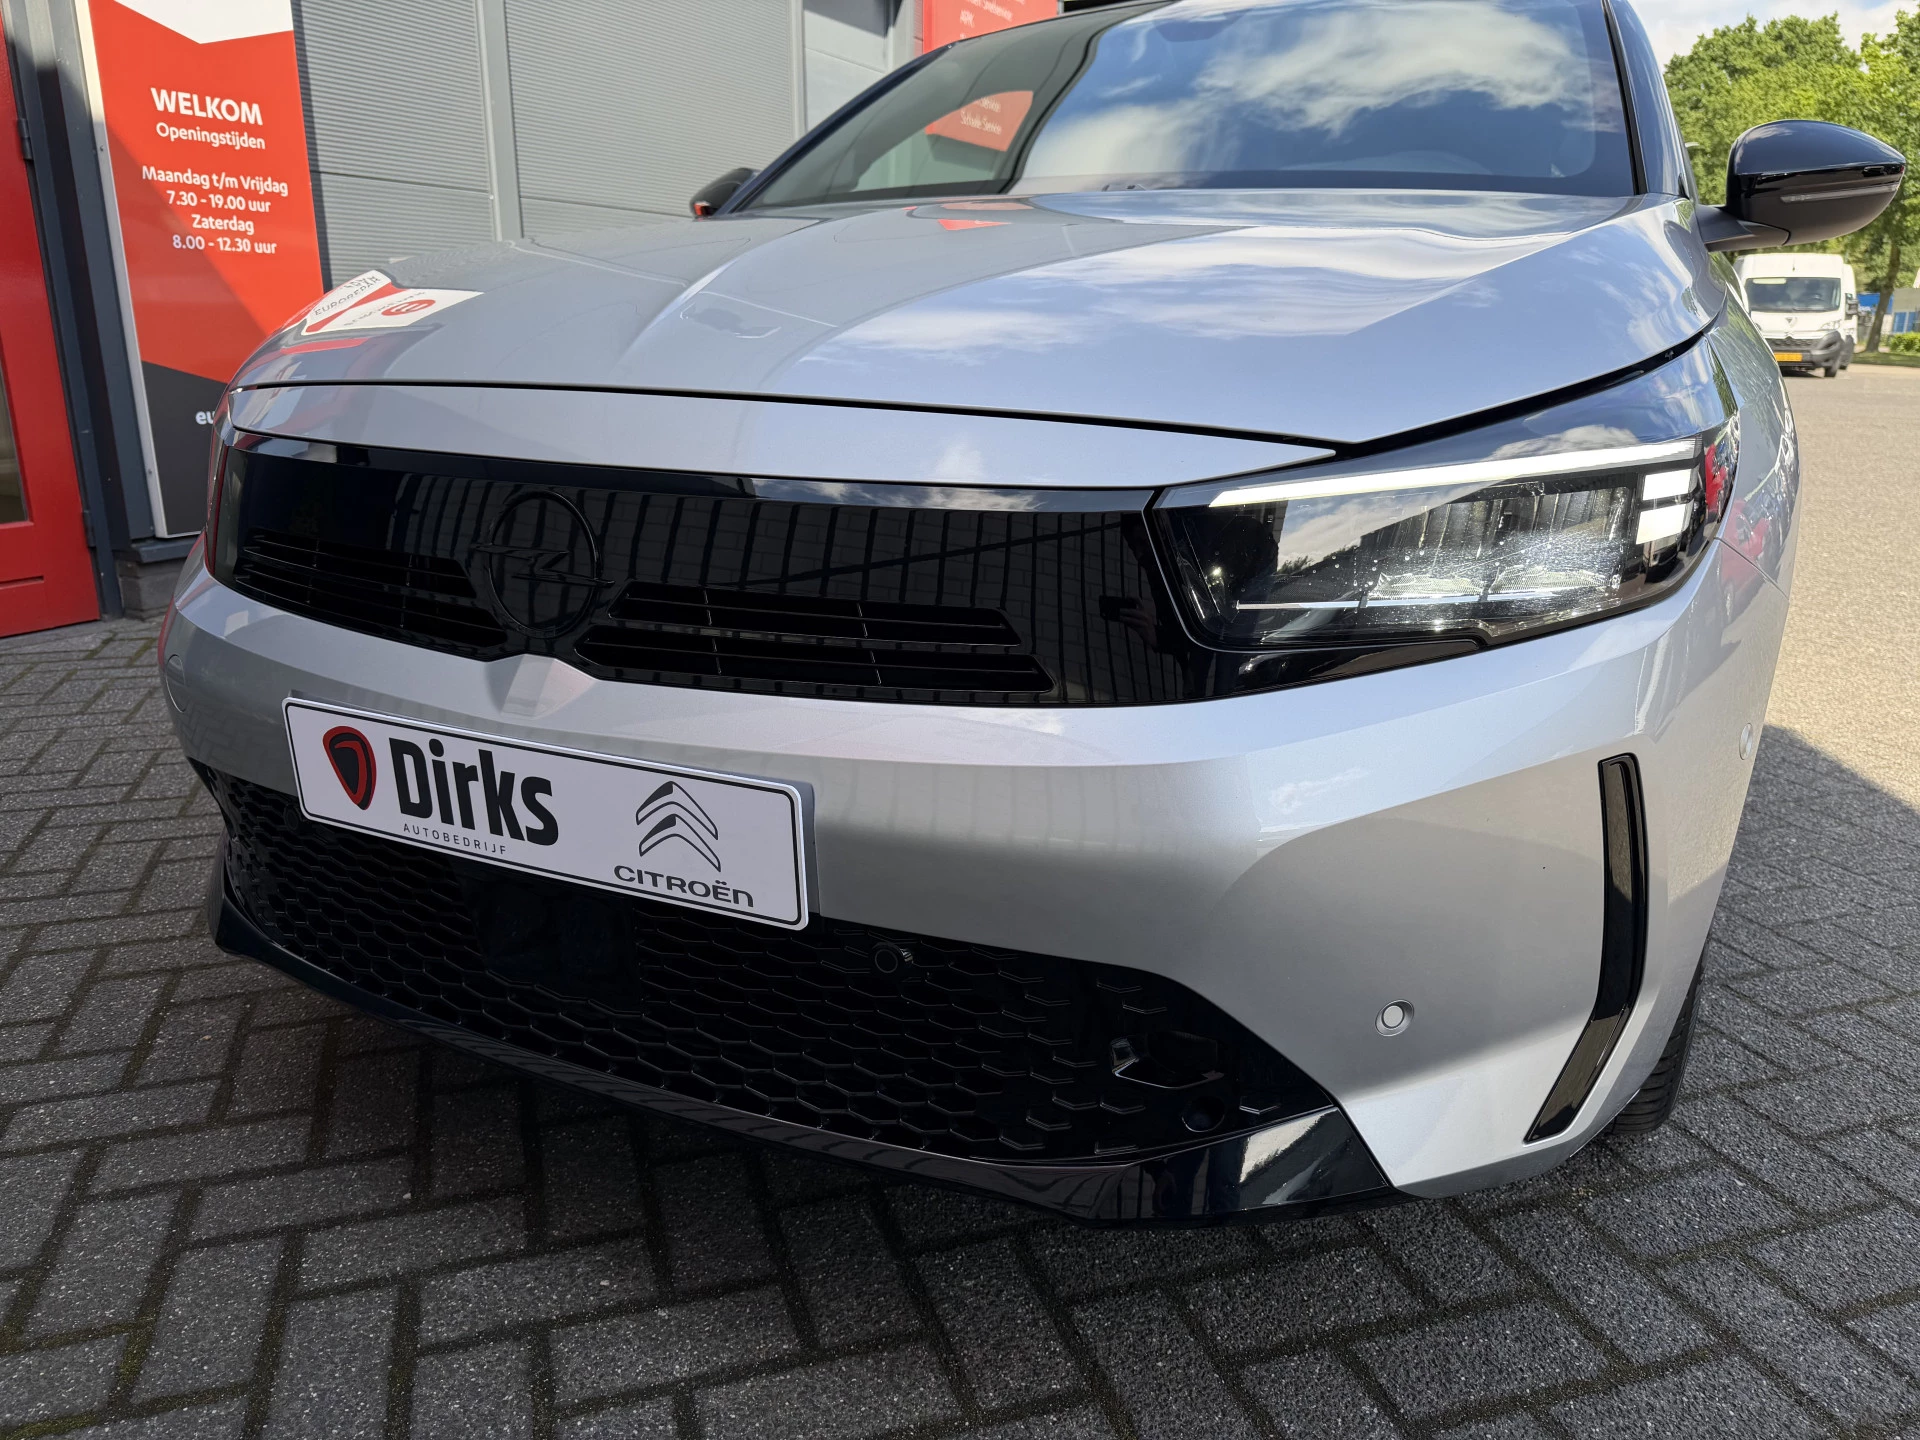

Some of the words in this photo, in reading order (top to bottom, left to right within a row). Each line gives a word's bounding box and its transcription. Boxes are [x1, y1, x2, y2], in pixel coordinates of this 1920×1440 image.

[150, 87, 263, 125] WELKOM
[156, 122, 265, 150] Openingstijden
[142, 165, 210, 189] Maandag
[212, 172, 238, 190] t/m
[240, 175, 288, 197] Vrijdag
[166, 190, 197, 206] 7.30
[209, 194, 246, 210] 19.00
[248, 199, 271, 212] uur
[191, 214, 254, 235] Zaterdag
[172, 234, 205, 250] 8.00
[217, 237, 251, 252] 12.30
[254, 241, 277, 254] uur
[389, 737, 559, 846] Dirks
[403, 823, 506, 855] AUTOBEDRIJF
[614, 865, 754, 908] CITROËN
